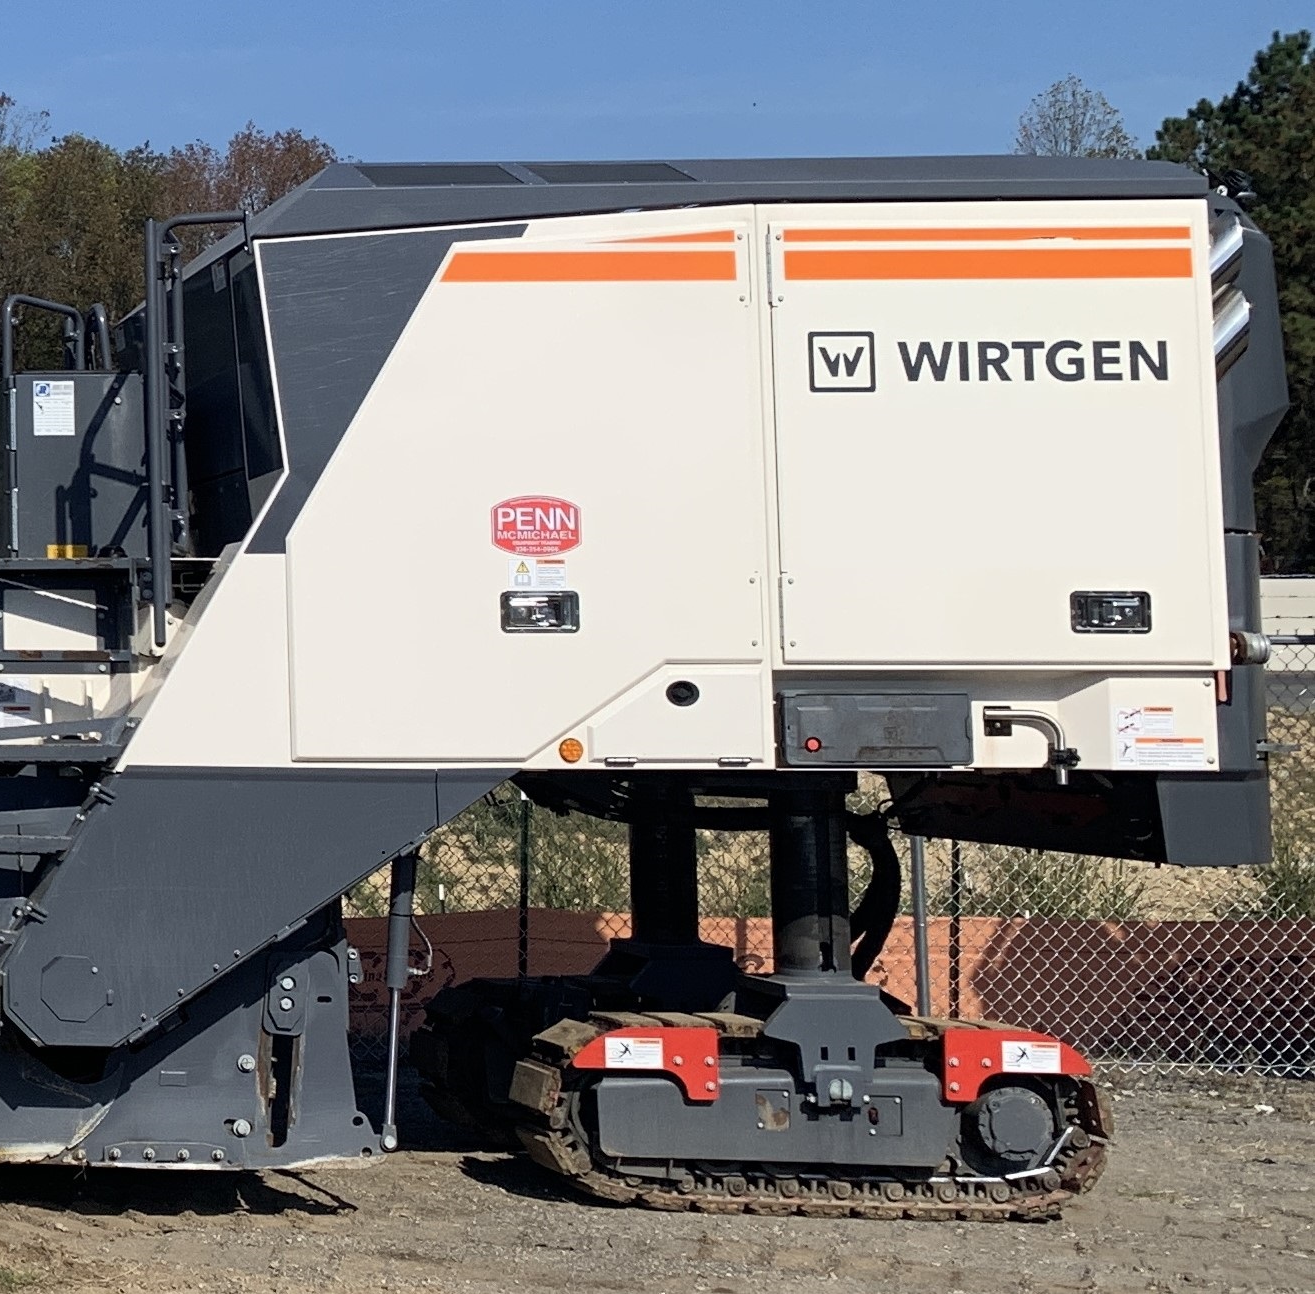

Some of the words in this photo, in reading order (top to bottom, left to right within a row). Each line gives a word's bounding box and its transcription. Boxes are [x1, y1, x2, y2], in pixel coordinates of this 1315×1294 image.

[896, 339, 1170, 383] WIRTGEN
[497, 507, 576, 531] PENN
[497, 530, 577, 540] MCMICHAEL
